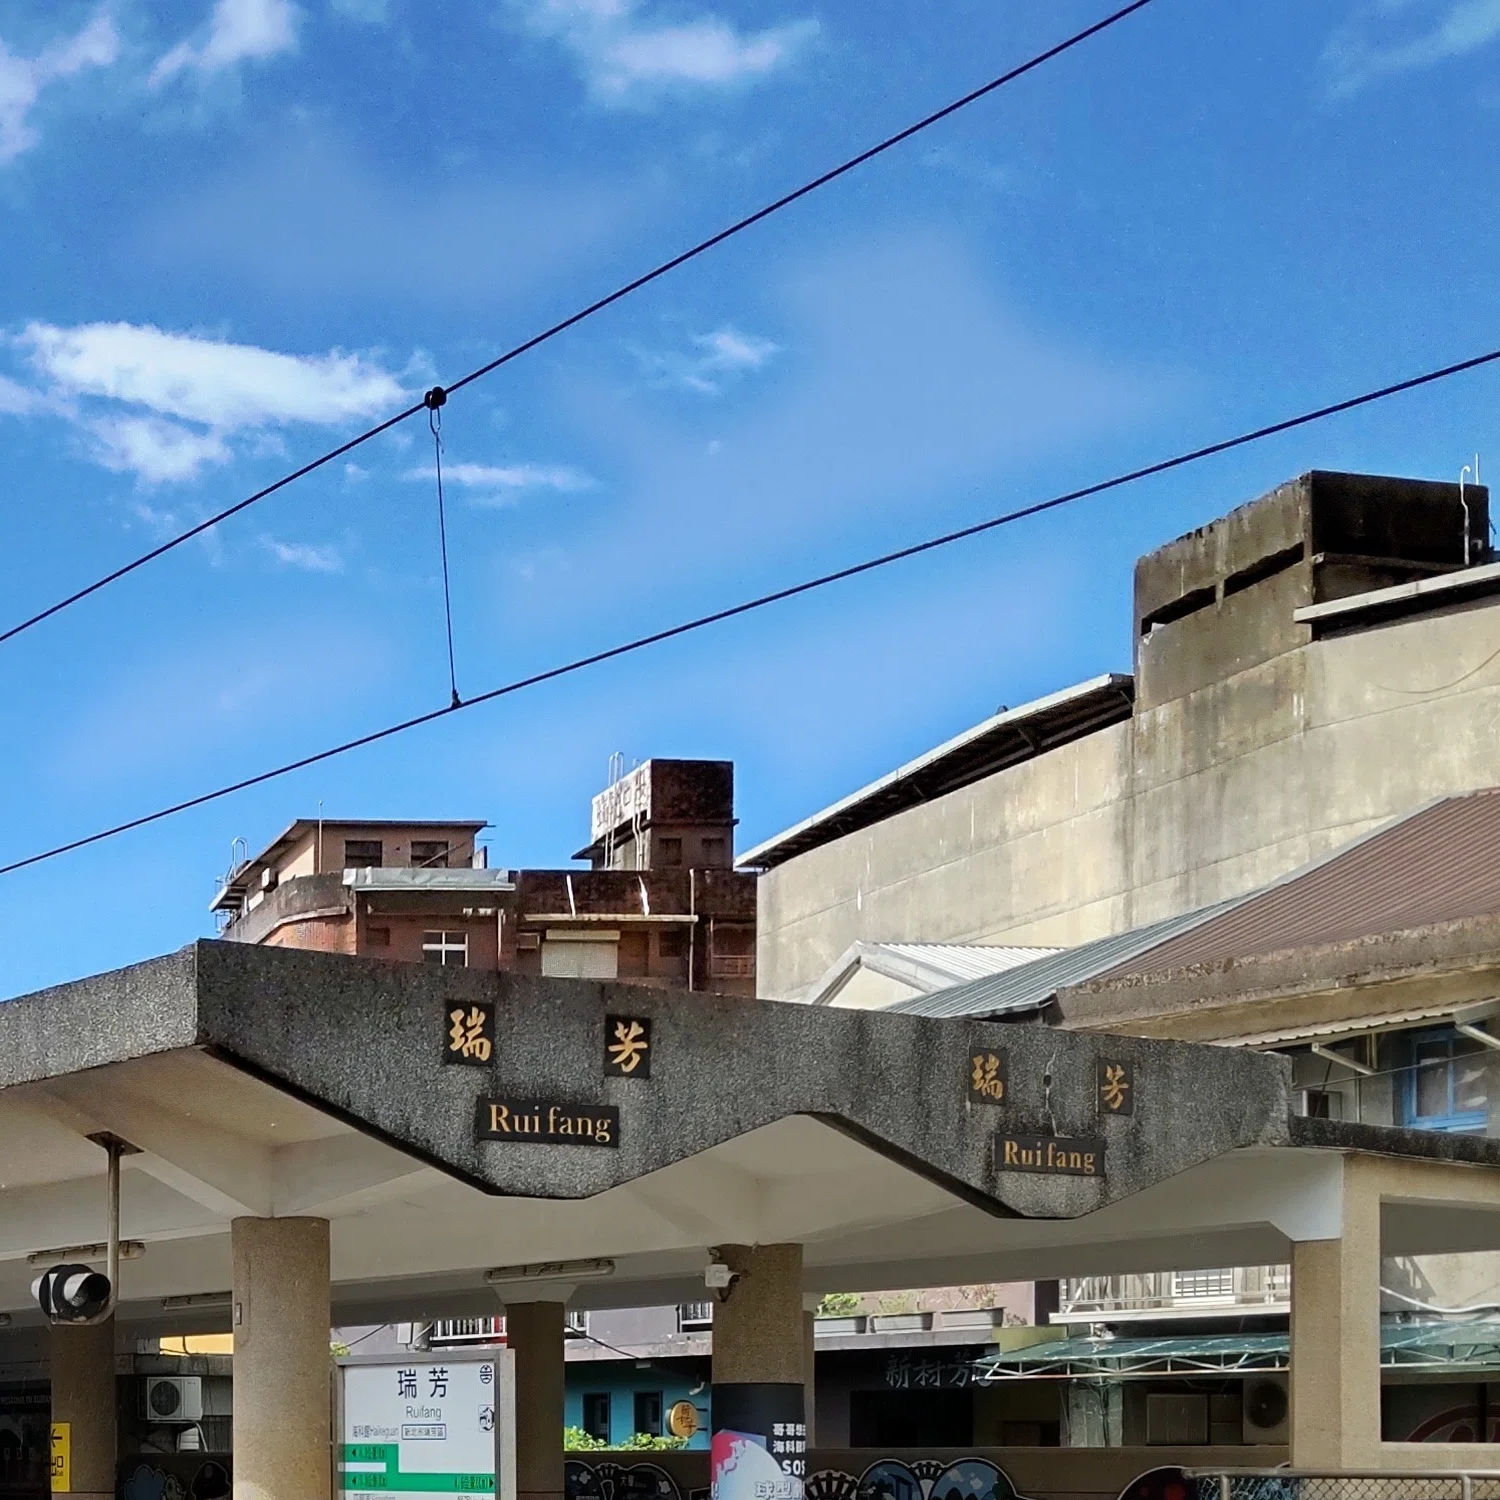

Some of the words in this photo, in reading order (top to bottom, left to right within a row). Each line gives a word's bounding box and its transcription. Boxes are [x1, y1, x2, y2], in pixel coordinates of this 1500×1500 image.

[448, 1005, 649, 1074] 瑞芳
[971, 1053, 1130, 1110] 瑞芳
[488, 1103, 612, 1143] Ruifang
[1003, 1140, 1097, 1174] Ruifang
[397, 1366, 449, 1399] 瑞芳
[405, 1405, 442, 1421] Ruifang
